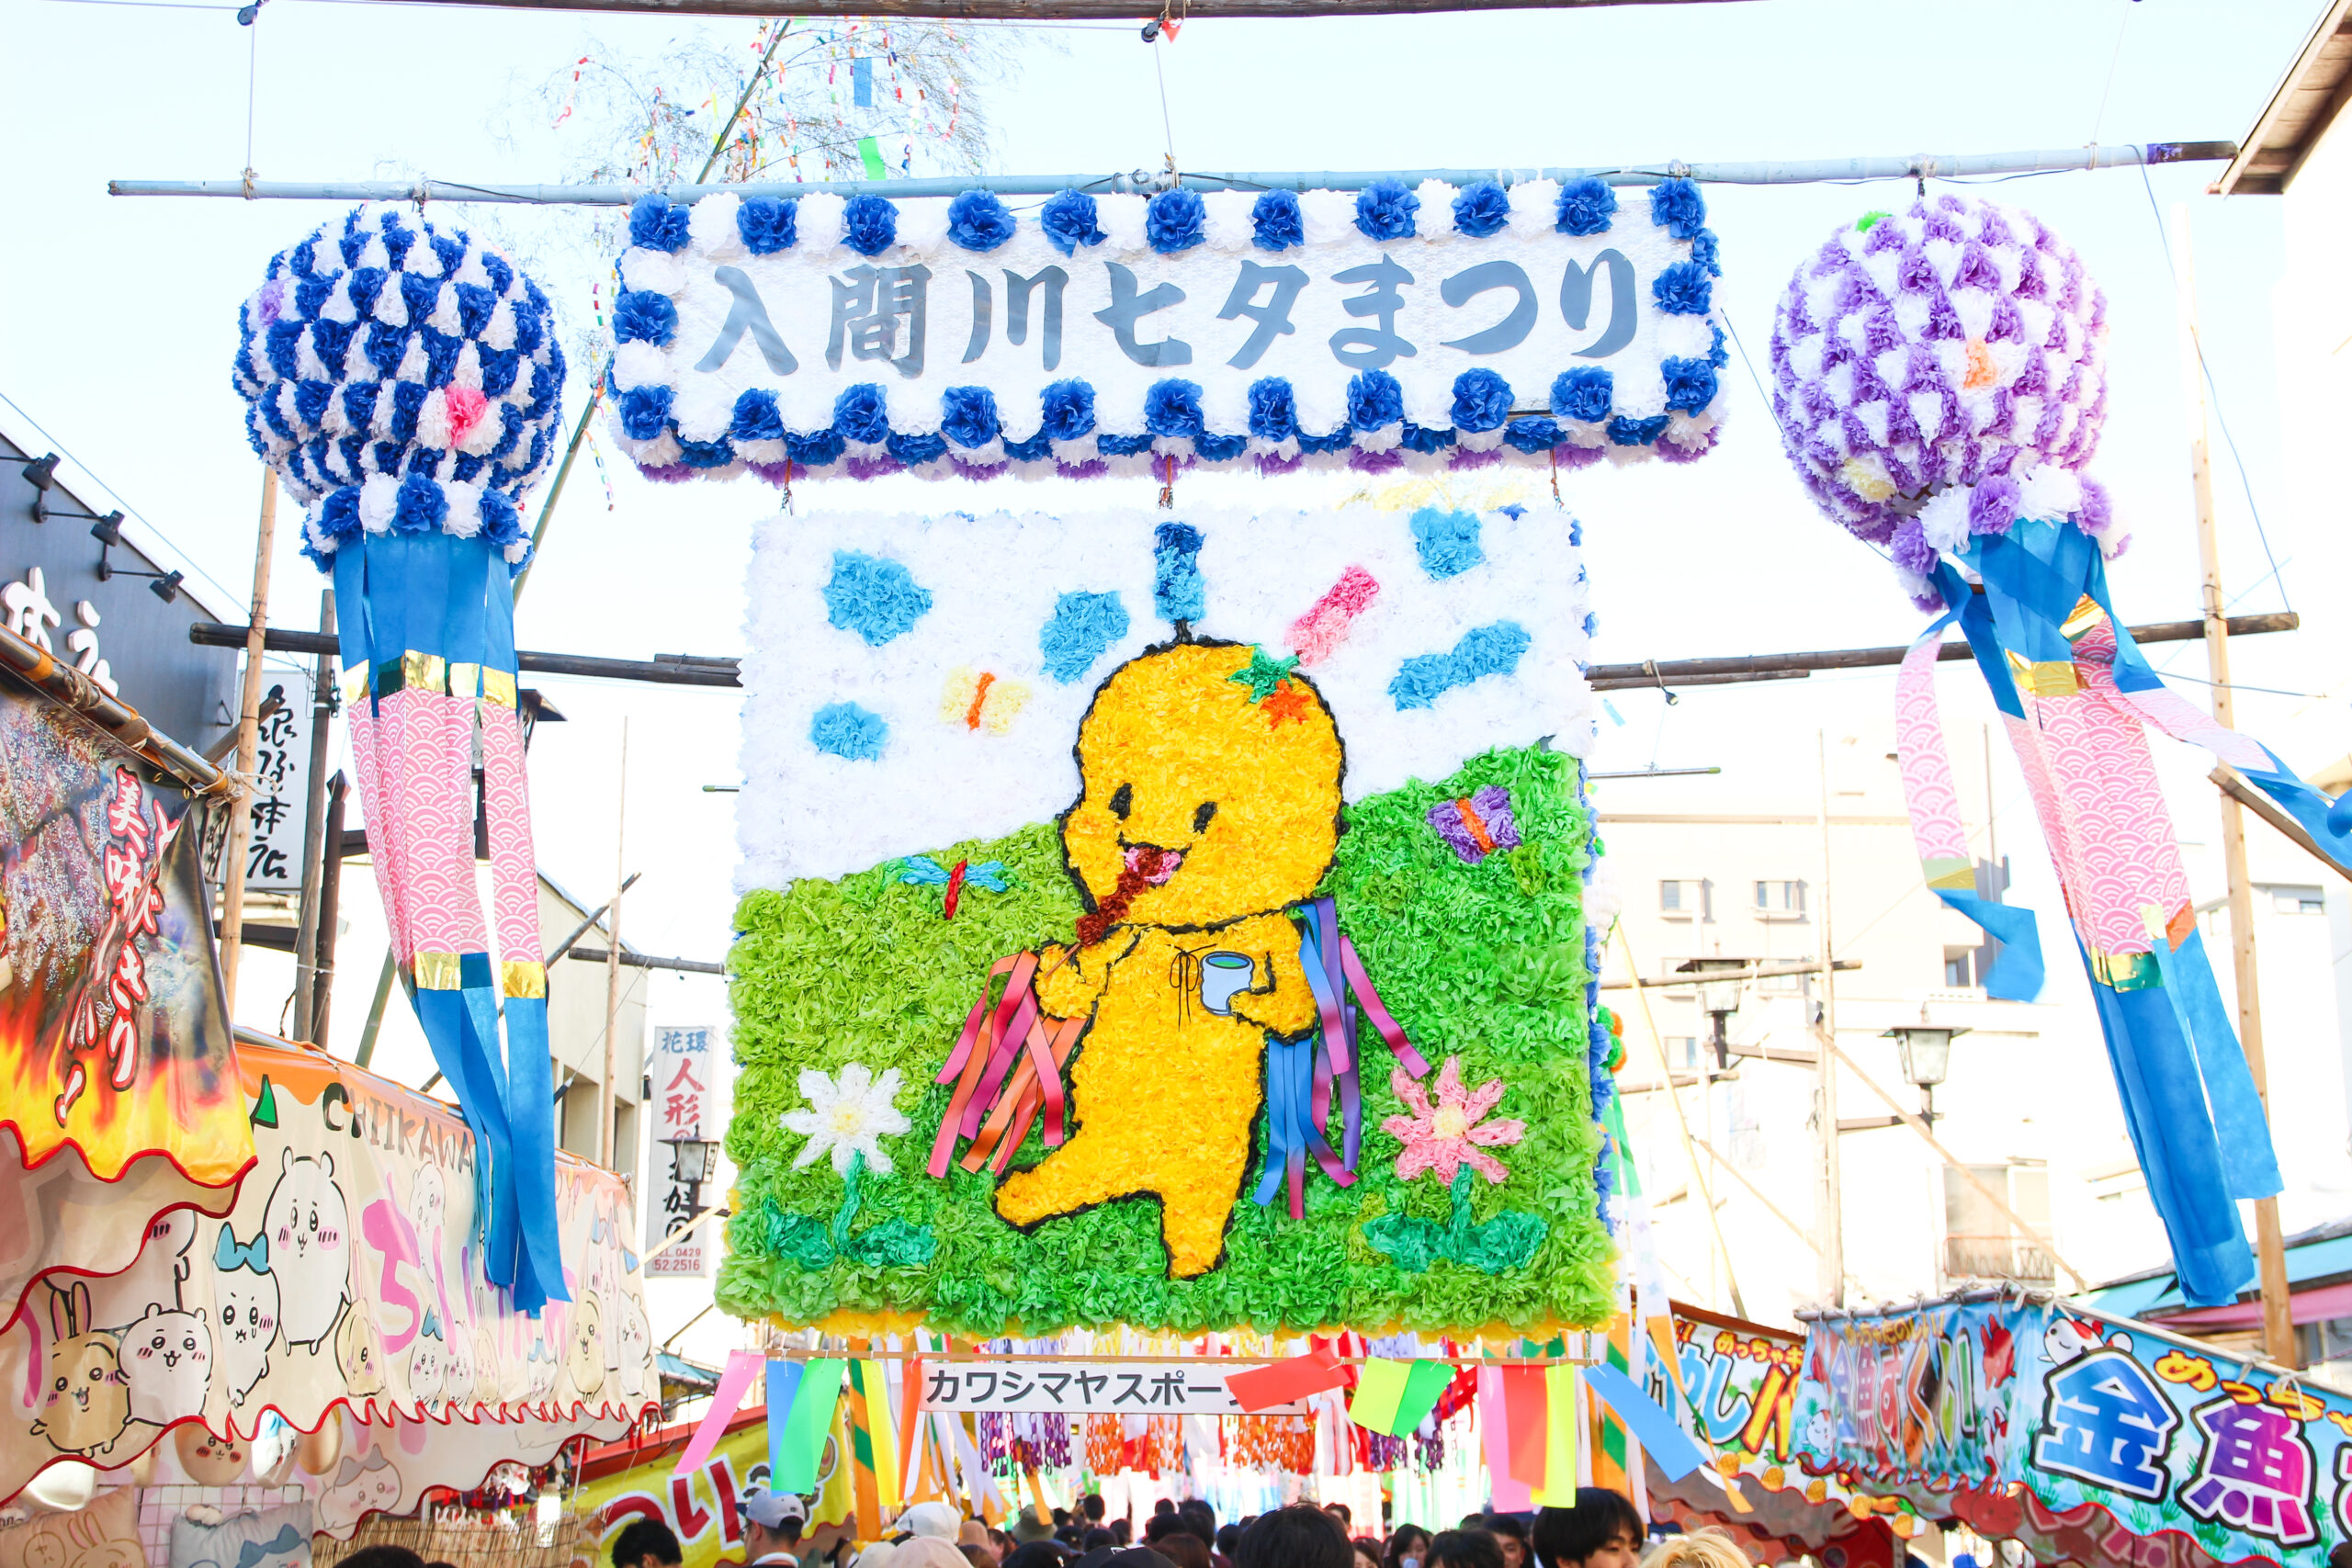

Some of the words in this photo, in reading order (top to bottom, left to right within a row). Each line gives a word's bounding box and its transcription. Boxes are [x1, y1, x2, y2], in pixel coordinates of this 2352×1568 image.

[693, 250, 1640, 378] 入間川七夕まつり
[660, 1030, 708, 1054] 花環
[323, 1082, 474, 1178] CHIIKAWA
[925, 1368, 1296, 1407] カワシマヤスポー
[2043, 1355, 2352, 1547] 金魚
